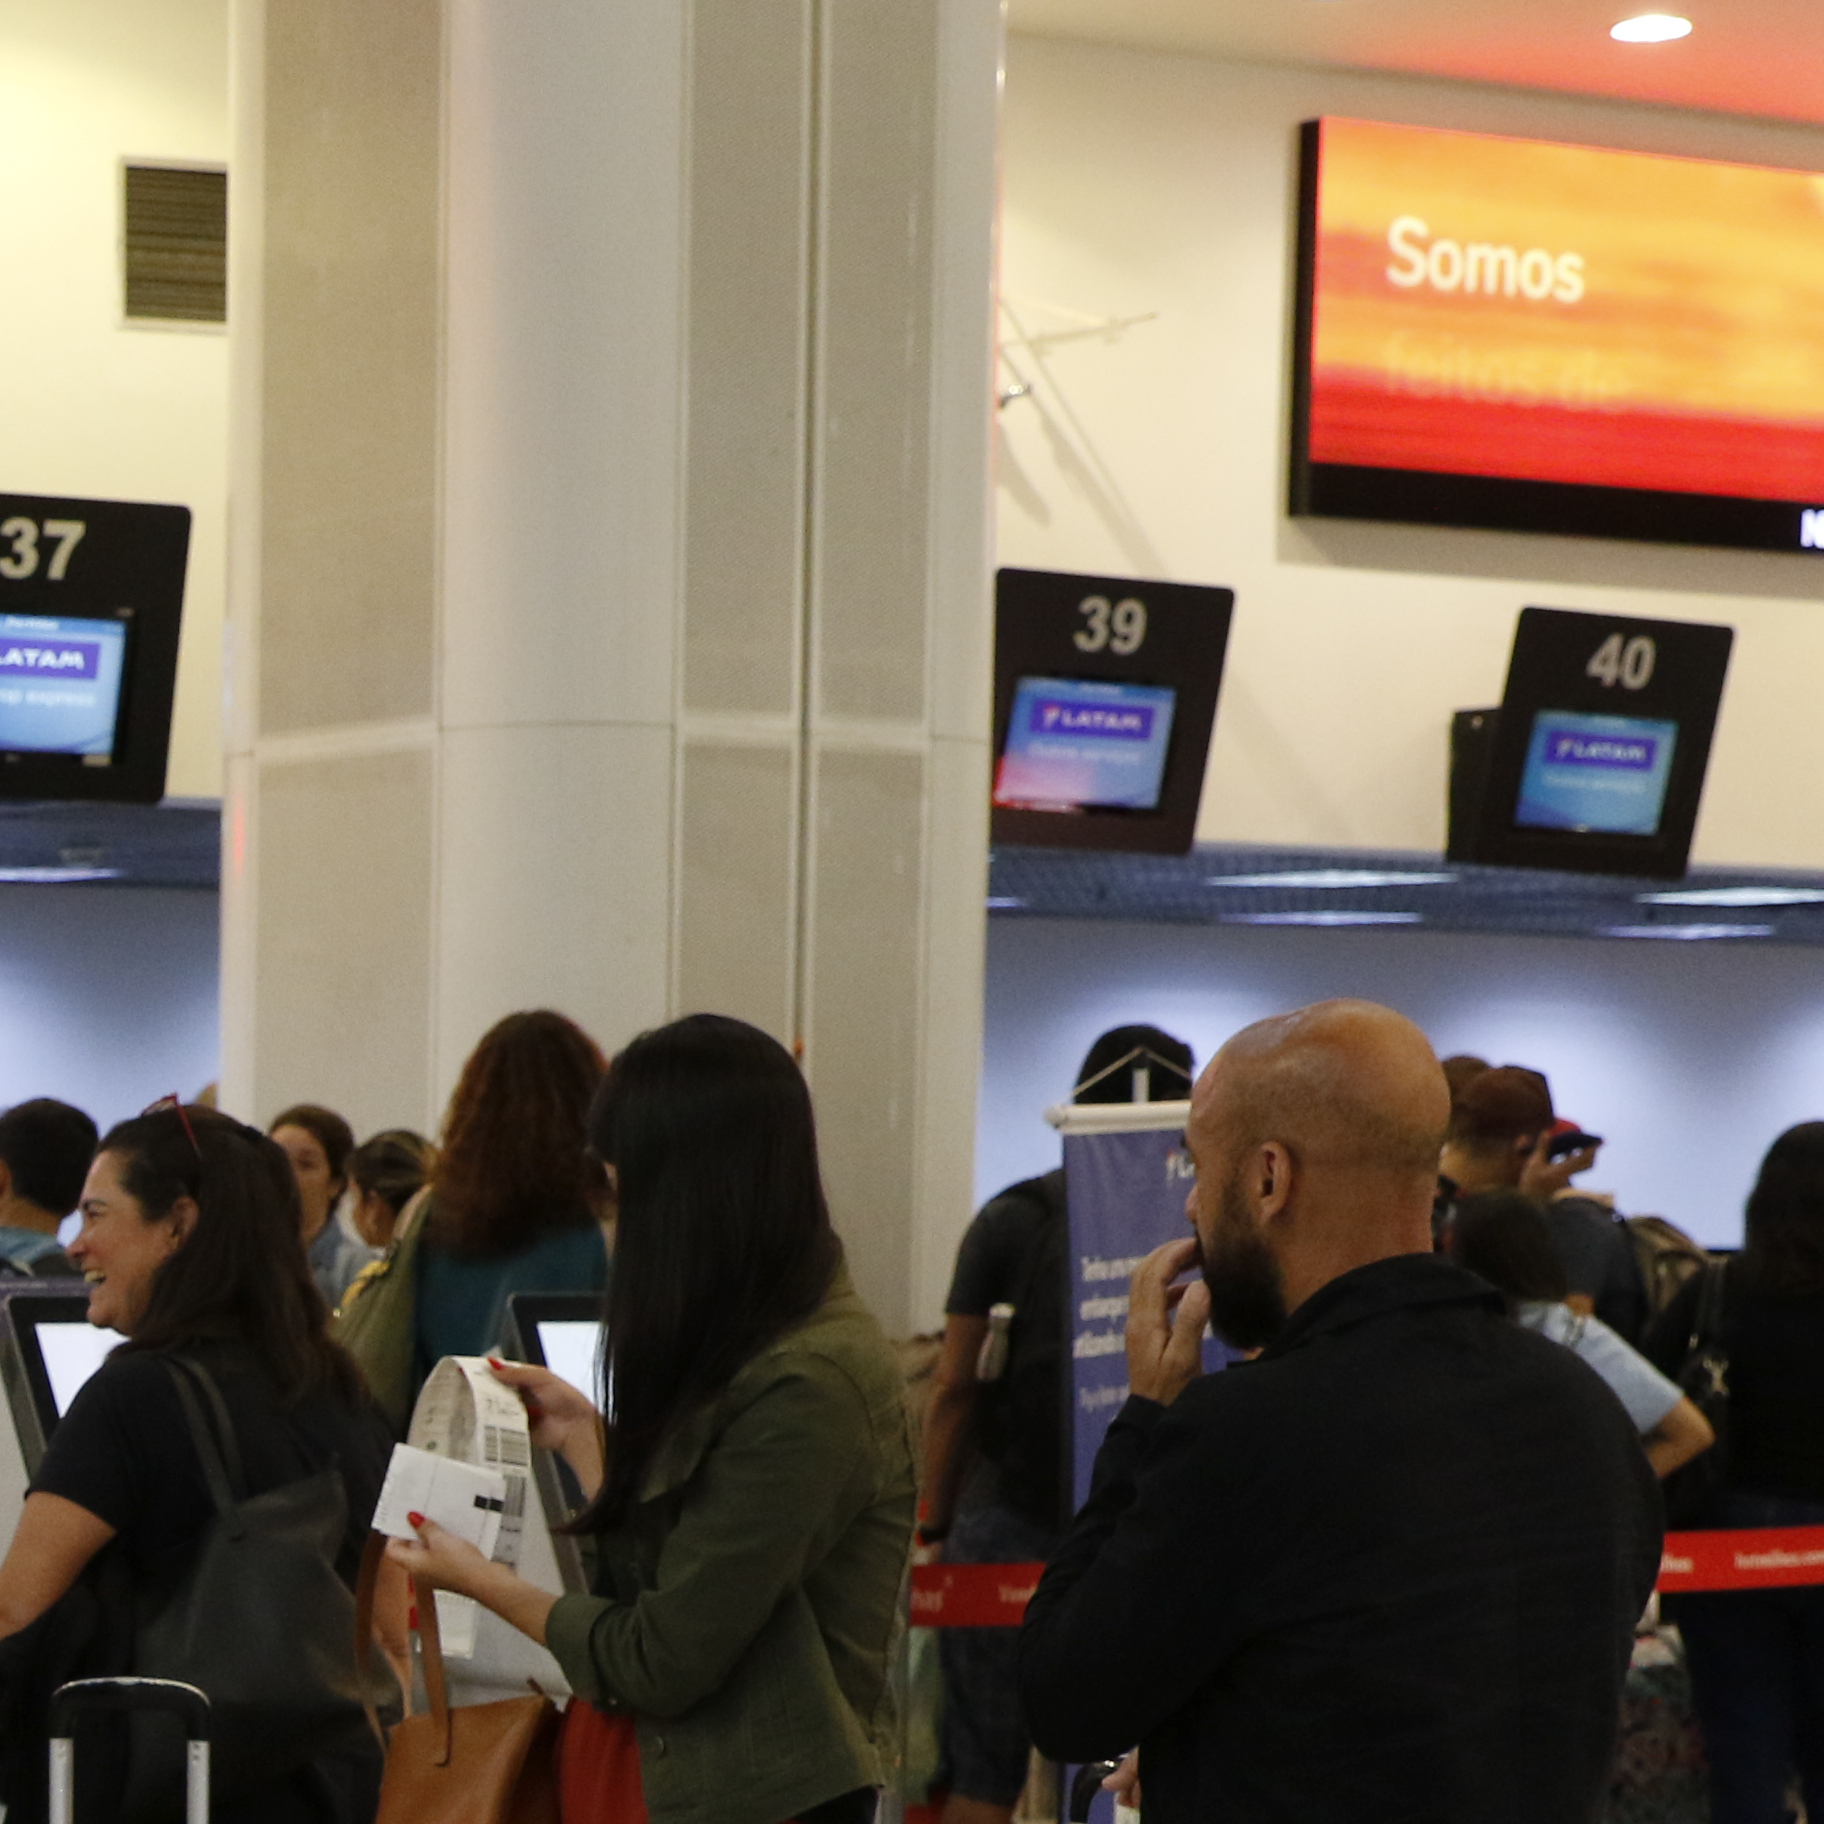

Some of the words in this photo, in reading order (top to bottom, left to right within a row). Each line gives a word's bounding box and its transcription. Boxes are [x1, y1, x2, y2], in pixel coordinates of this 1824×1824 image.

[1385, 214, 1587, 304] Somos
[1072, 596, 1148, 655] 39
[1586, 633, 1656, 691] 40
